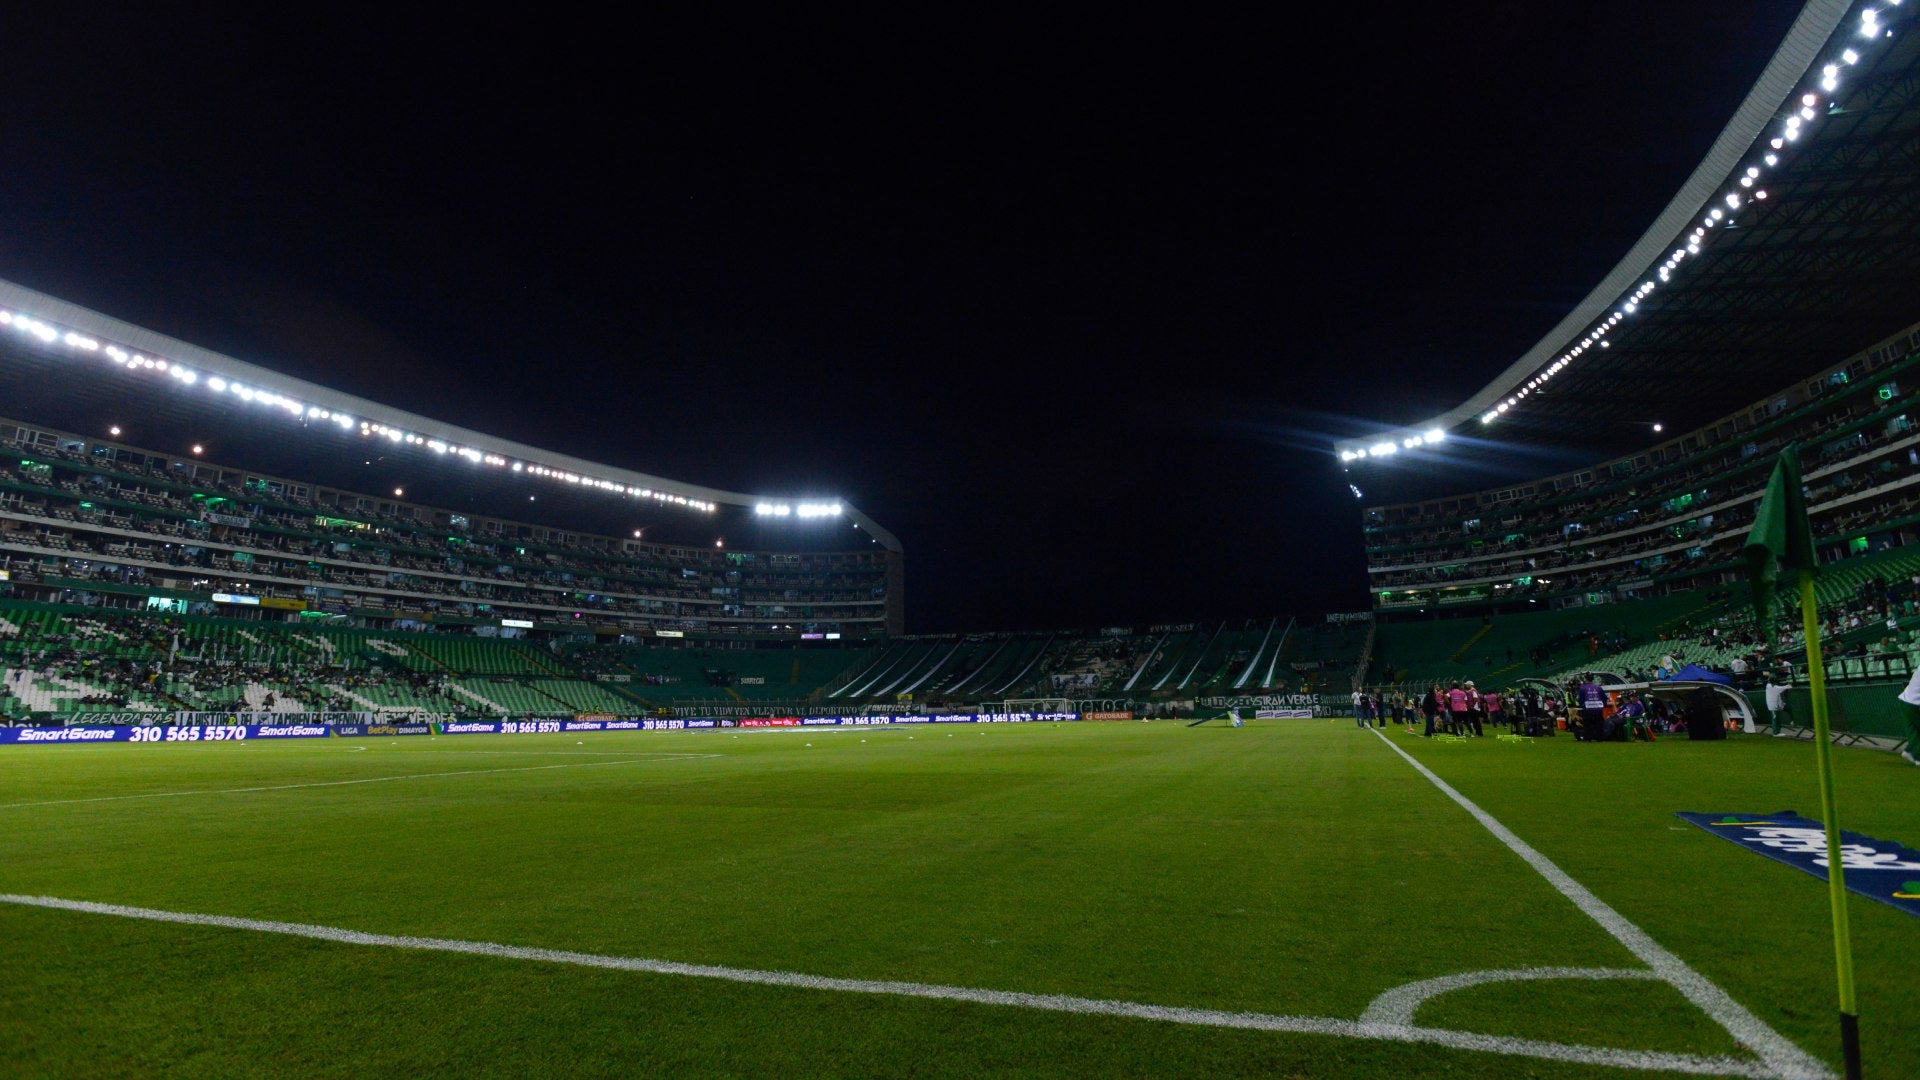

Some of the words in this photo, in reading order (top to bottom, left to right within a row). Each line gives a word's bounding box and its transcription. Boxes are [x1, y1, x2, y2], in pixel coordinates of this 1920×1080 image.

[674, 706, 697, 716] VIVE
[699, 706, 711, 716] TU
[68, 711, 174, 725] LEGENDARIAS
[841, 717, 853, 725] 310
[855, 717, 868, 725] 565
[870, 716, 889, 725] 5570
[976, 714, 990, 723] 310
[992, 714, 1008, 722] 565
[341, 727, 358, 735] LIGA
[367, 725, 398, 736] BetPlay
[398, 727, 428, 735] DIMAYOR
[447, 723, 494, 733] SmartGame
[500, 722, 517, 733] 310
[519, 722, 536, 733] 565
[538, 721, 560, 732] 5570
[566, 722, 601, 730] SmartGame
[606, 721, 639, 729] SmartGame
[642, 720, 654, 730] 310
[655, 720, 668, 730] 565
[669, 719, 685, 729] 5570
[17, 728, 116, 742] SmartGame
[129, 727, 162, 742] 310
[166, 726, 200, 742] 565
[204, 725, 247, 741] 5570
[258, 725, 325, 737] SmartGame
